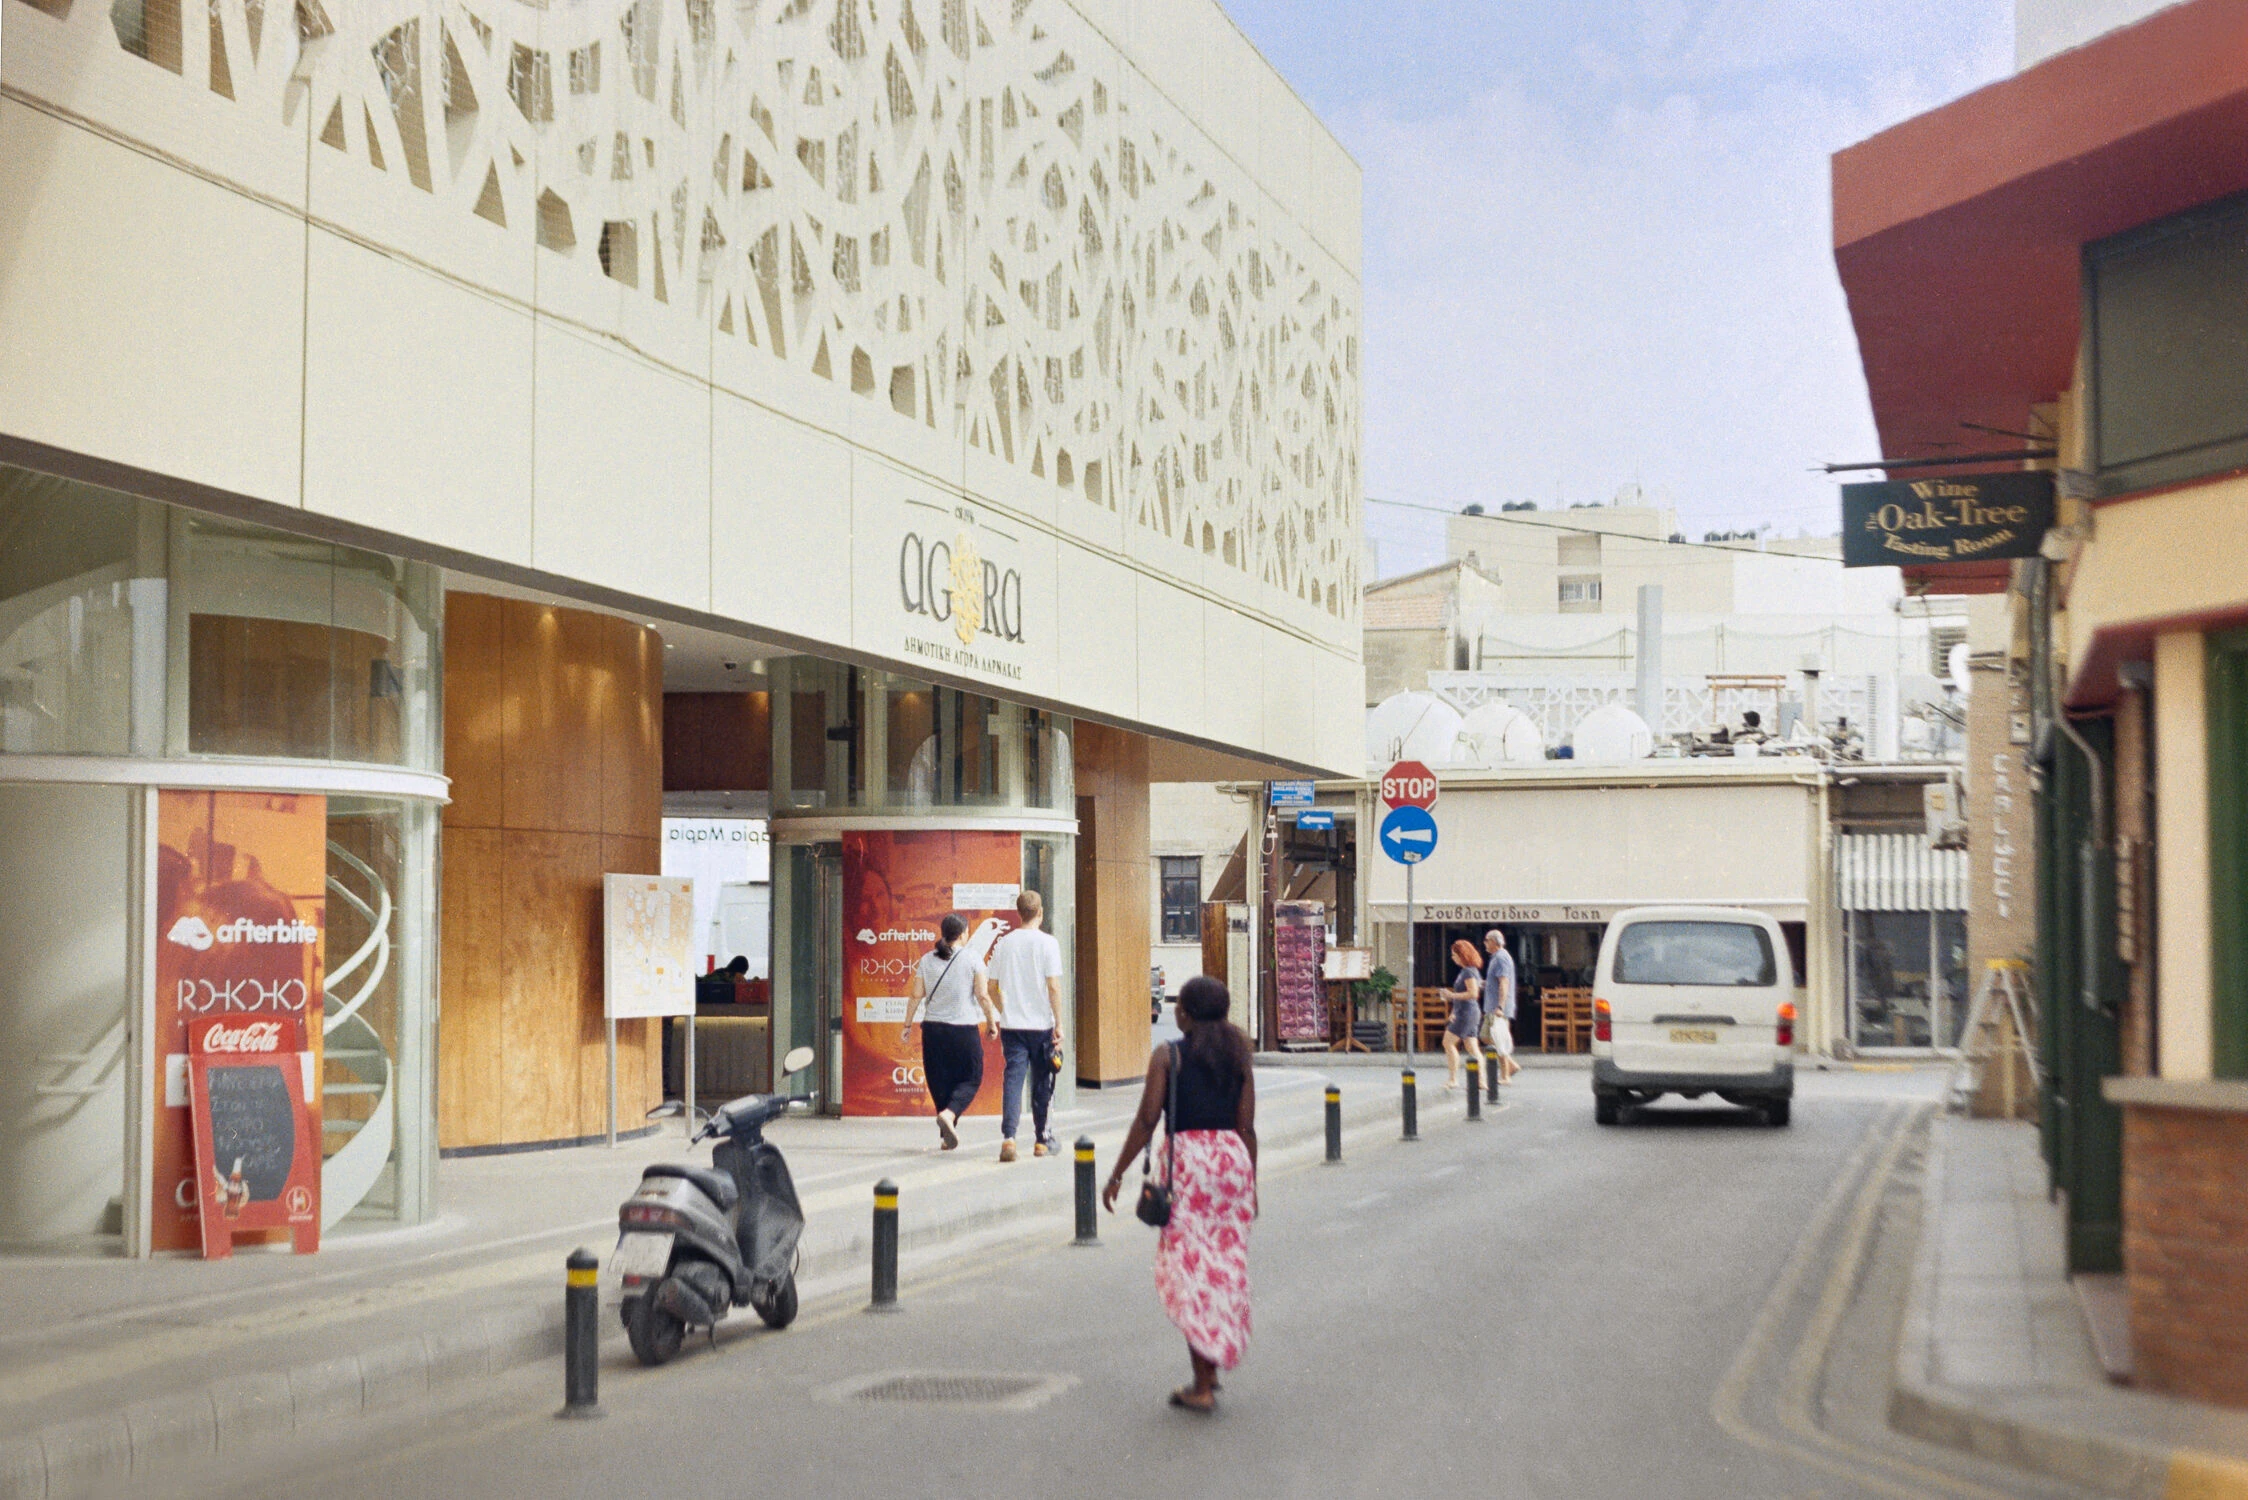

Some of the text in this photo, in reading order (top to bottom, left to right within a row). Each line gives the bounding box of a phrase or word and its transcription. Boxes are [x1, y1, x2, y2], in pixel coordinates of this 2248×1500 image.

[1910, 479, 1980, 499] Wine
[1878, 498, 2028, 531] Oak-Tree
[1883, 528, 2016, 560] Tasting Room
[904, 636, 1022, 681] ΔΗΜΟΤΙΚΗ ΑΓΟΡΑ ΛΑΡΝΑΚΑΣ
[1383, 777, 1435, 799] STOP
[216, 917, 318, 943] afterbite
[878, 928, 936, 942] afterbite
[860, 959, 920, 975] ROKOK
